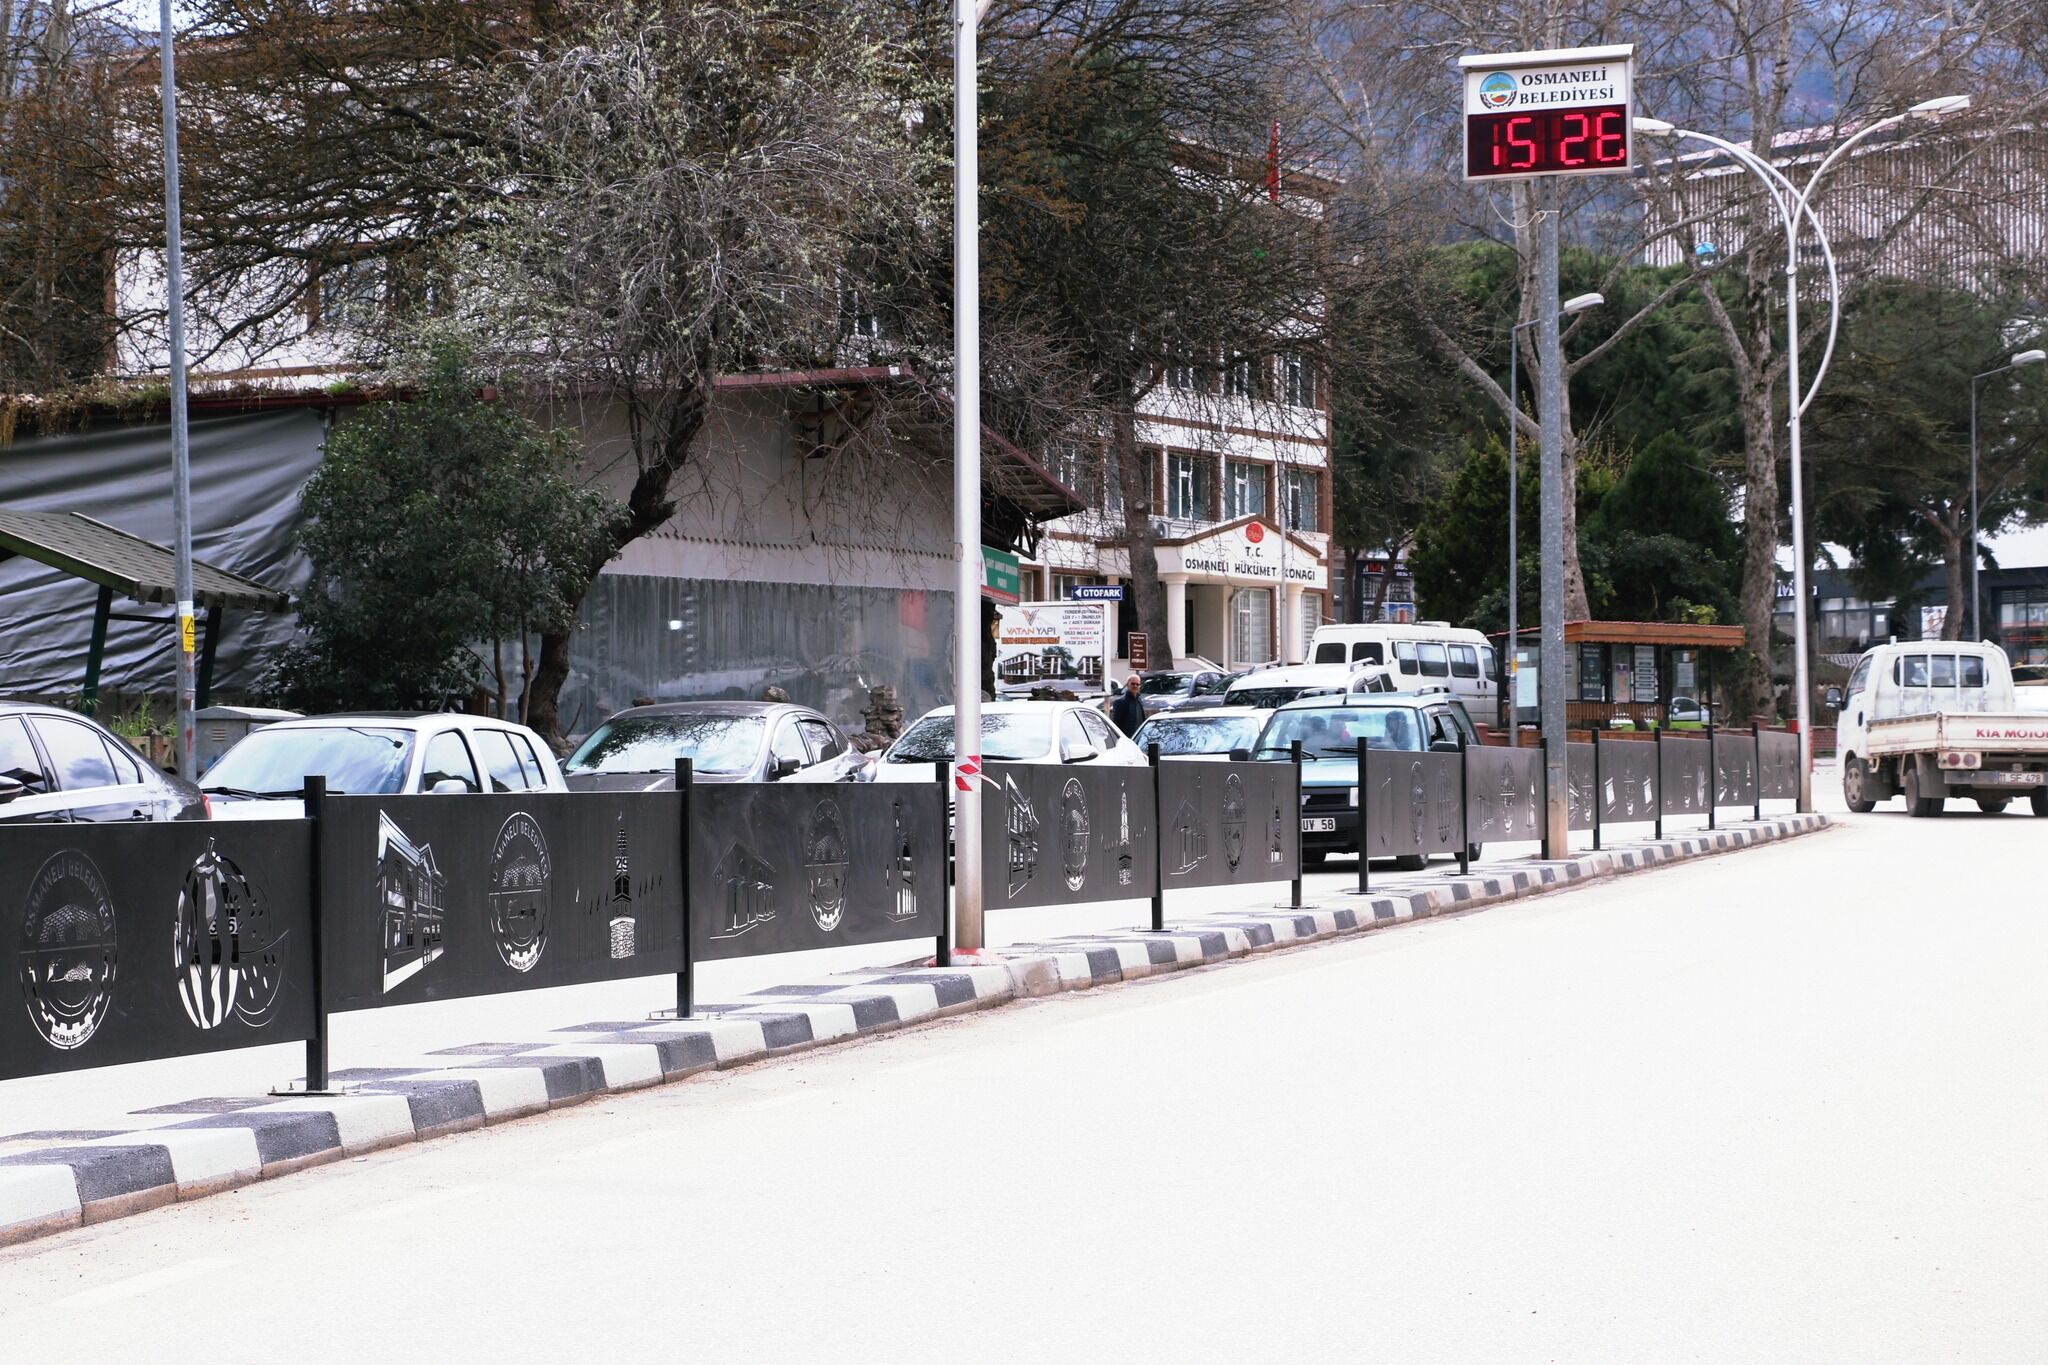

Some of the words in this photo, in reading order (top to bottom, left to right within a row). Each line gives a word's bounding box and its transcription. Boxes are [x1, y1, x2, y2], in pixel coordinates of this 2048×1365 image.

[1521, 66, 1607, 86] OSMANELİ
[1519, 84, 1615, 105] BELEDİYESİ
[1493, 117, 1536, 167] 15
[1234, 560, 1277, 577] HÜKÜMET
[1083, 589, 1120, 597] OTOPARK
[1006, 627, 1035, 635] VATAN
[1036, 627, 1056, 635] YAPI
[1976, 729, 2000, 738] KIA
[1302, 819, 1315, 831] UV
[1321, 819, 1334, 830] 58
